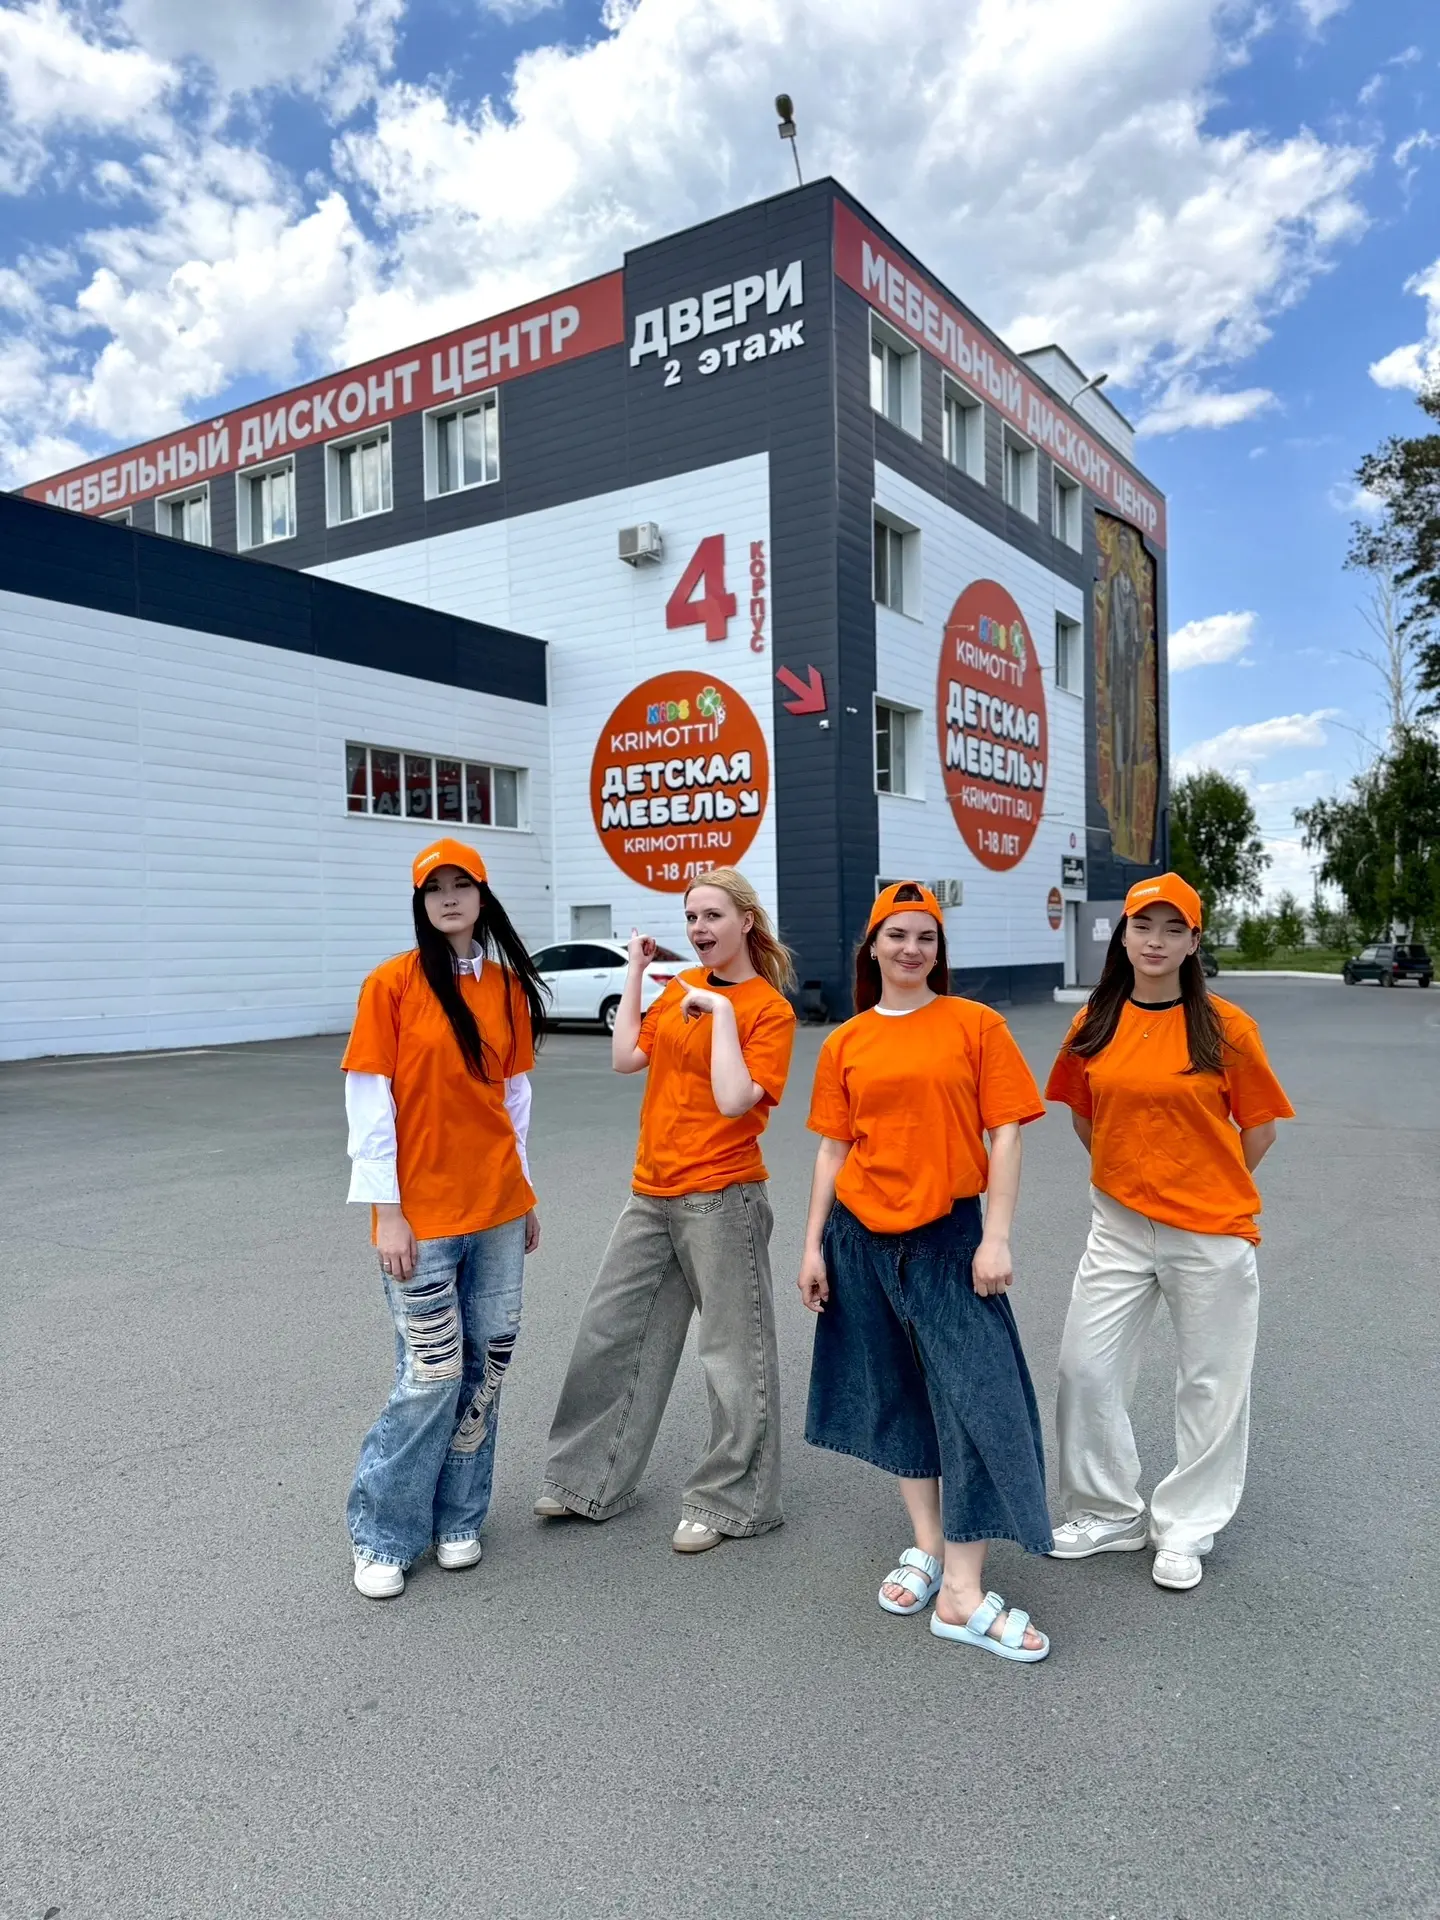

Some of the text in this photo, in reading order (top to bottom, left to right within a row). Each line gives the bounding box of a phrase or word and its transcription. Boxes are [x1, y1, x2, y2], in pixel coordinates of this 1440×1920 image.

[630, 260, 803, 367] ДВЕРИ
[664, 319, 805, 387] 2 этаж
[45, 305, 580, 513] МЕБЕЛЬНЫЙ ДИСКОНТ ЦЕНТР
[862, 239, 1157, 531] МЕБЕЛЬНЫЙ ДИСКОНТ ЦЕНТР
[665, 533, 737, 642] 4
[749, 540, 766, 653] КОРПУС
[956, 637, 1023, 687] KRIMOTTI
[611, 723, 714, 753] KRIMOTTI
[946, 680, 1039, 748] ДЕТСКАЯ
[601, 750, 751, 800] ДЕТСКАЯ
[962, 784, 1032, 821] KRIMOTTI.RU
[624, 831, 732, 853] KRIMOTTI.RU
[683, 860, 715, 879] ЛЕТ
[1001, 833, 1020, 856] ЛЕТ
